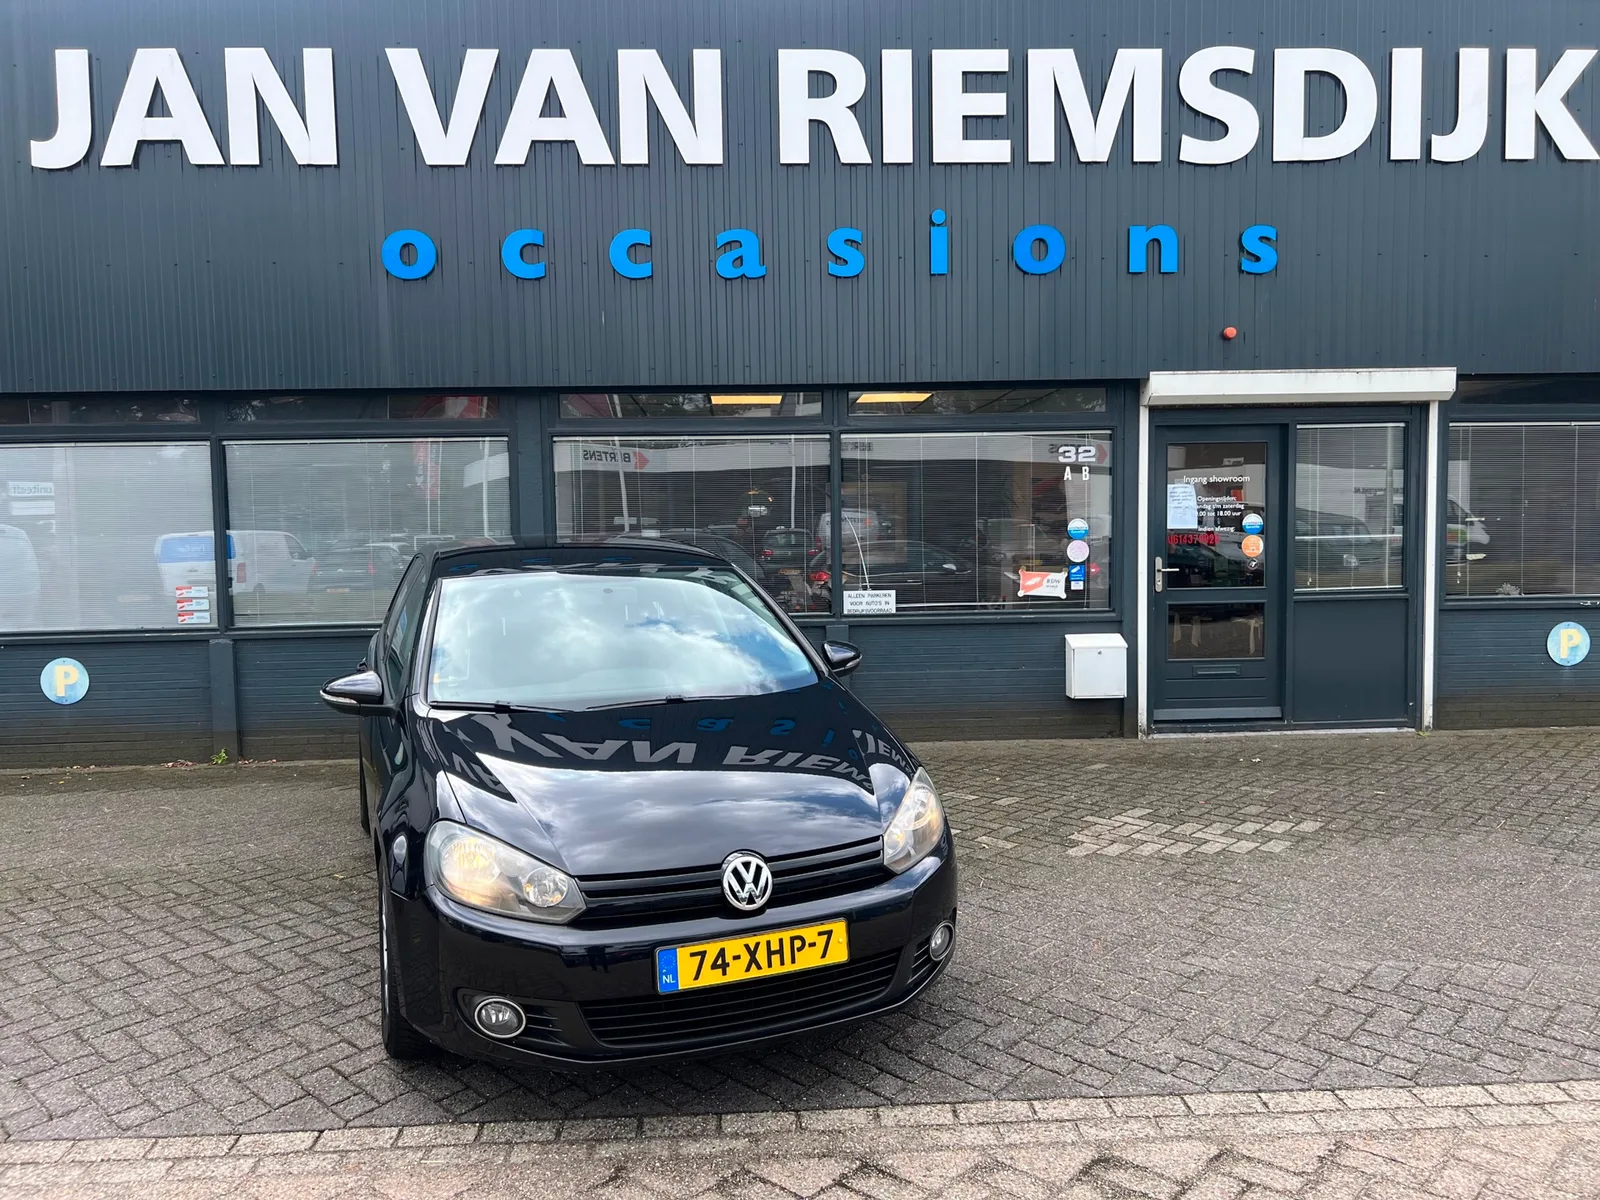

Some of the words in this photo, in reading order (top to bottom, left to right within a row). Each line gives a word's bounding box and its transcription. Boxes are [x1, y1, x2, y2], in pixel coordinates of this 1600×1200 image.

[30, 47, 339, 170] JAN
[384, 47, 724, 166] VAN
[778, 46, 1600, 166] RIEMSDIJK
[381, 209, 1279, 281] occasions
[1058, 445, 1096, 463] 32
[1063, 465, 1072, 481] A
[1081, 465, 1090, 481] B
[1183, 475, 1208, 485] Ingang
[1209, 475, 1251, 483] showroom
[1559, 628, 1581, 659] P
[55, 664, 79, 697] P
[689, 929, 834, 981] 74-XHP-7
[662, 974, 676, 984] NL
